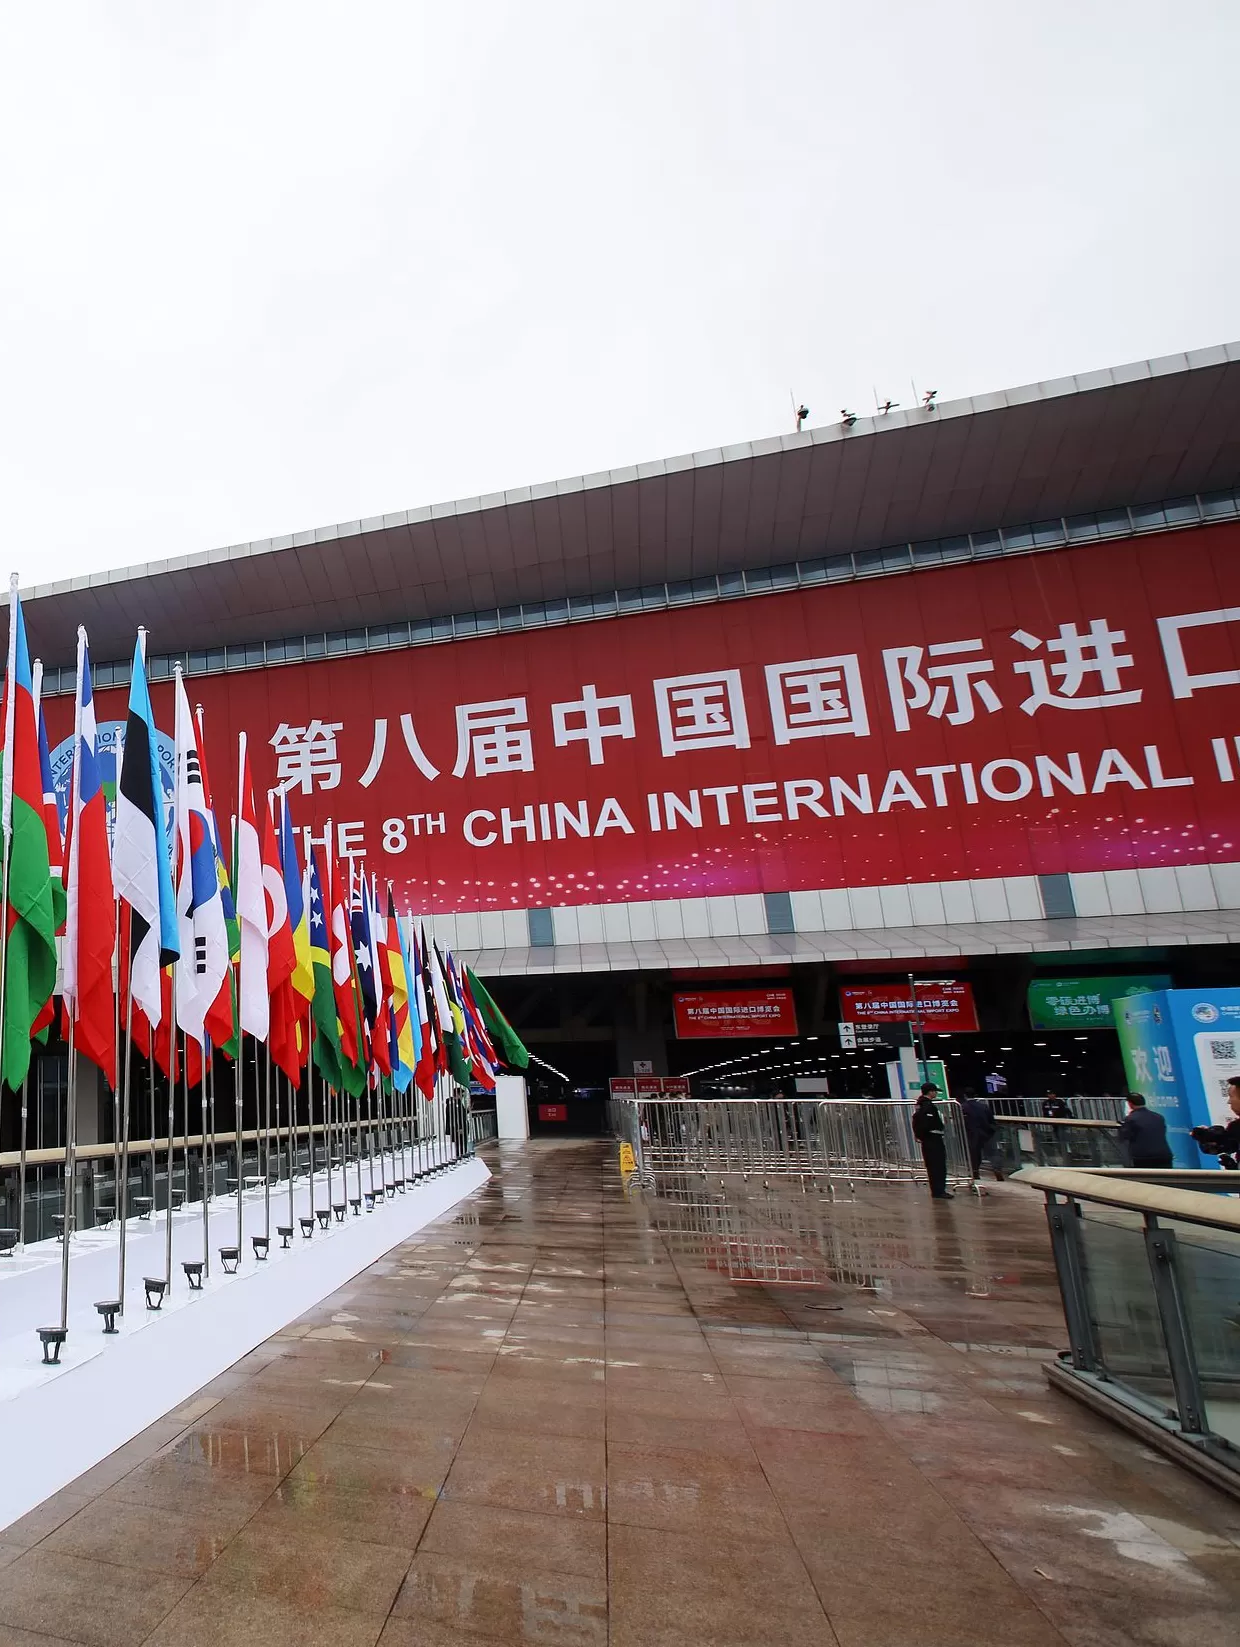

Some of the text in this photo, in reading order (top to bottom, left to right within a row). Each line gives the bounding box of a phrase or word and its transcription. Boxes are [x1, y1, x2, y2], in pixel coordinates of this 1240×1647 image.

[268, 607, 1240, 796] 第八届中国国际进口
[382, 812, 446, 854] 8TH
[463, 798, 635, 847] CHINA
[647, 745, 1195, 832] INTERNATIONAL
[687, 1005, 780, 1015] 第八届中国国际进口博览会
[1131, 1046, 1175, 1083] 欢迎
